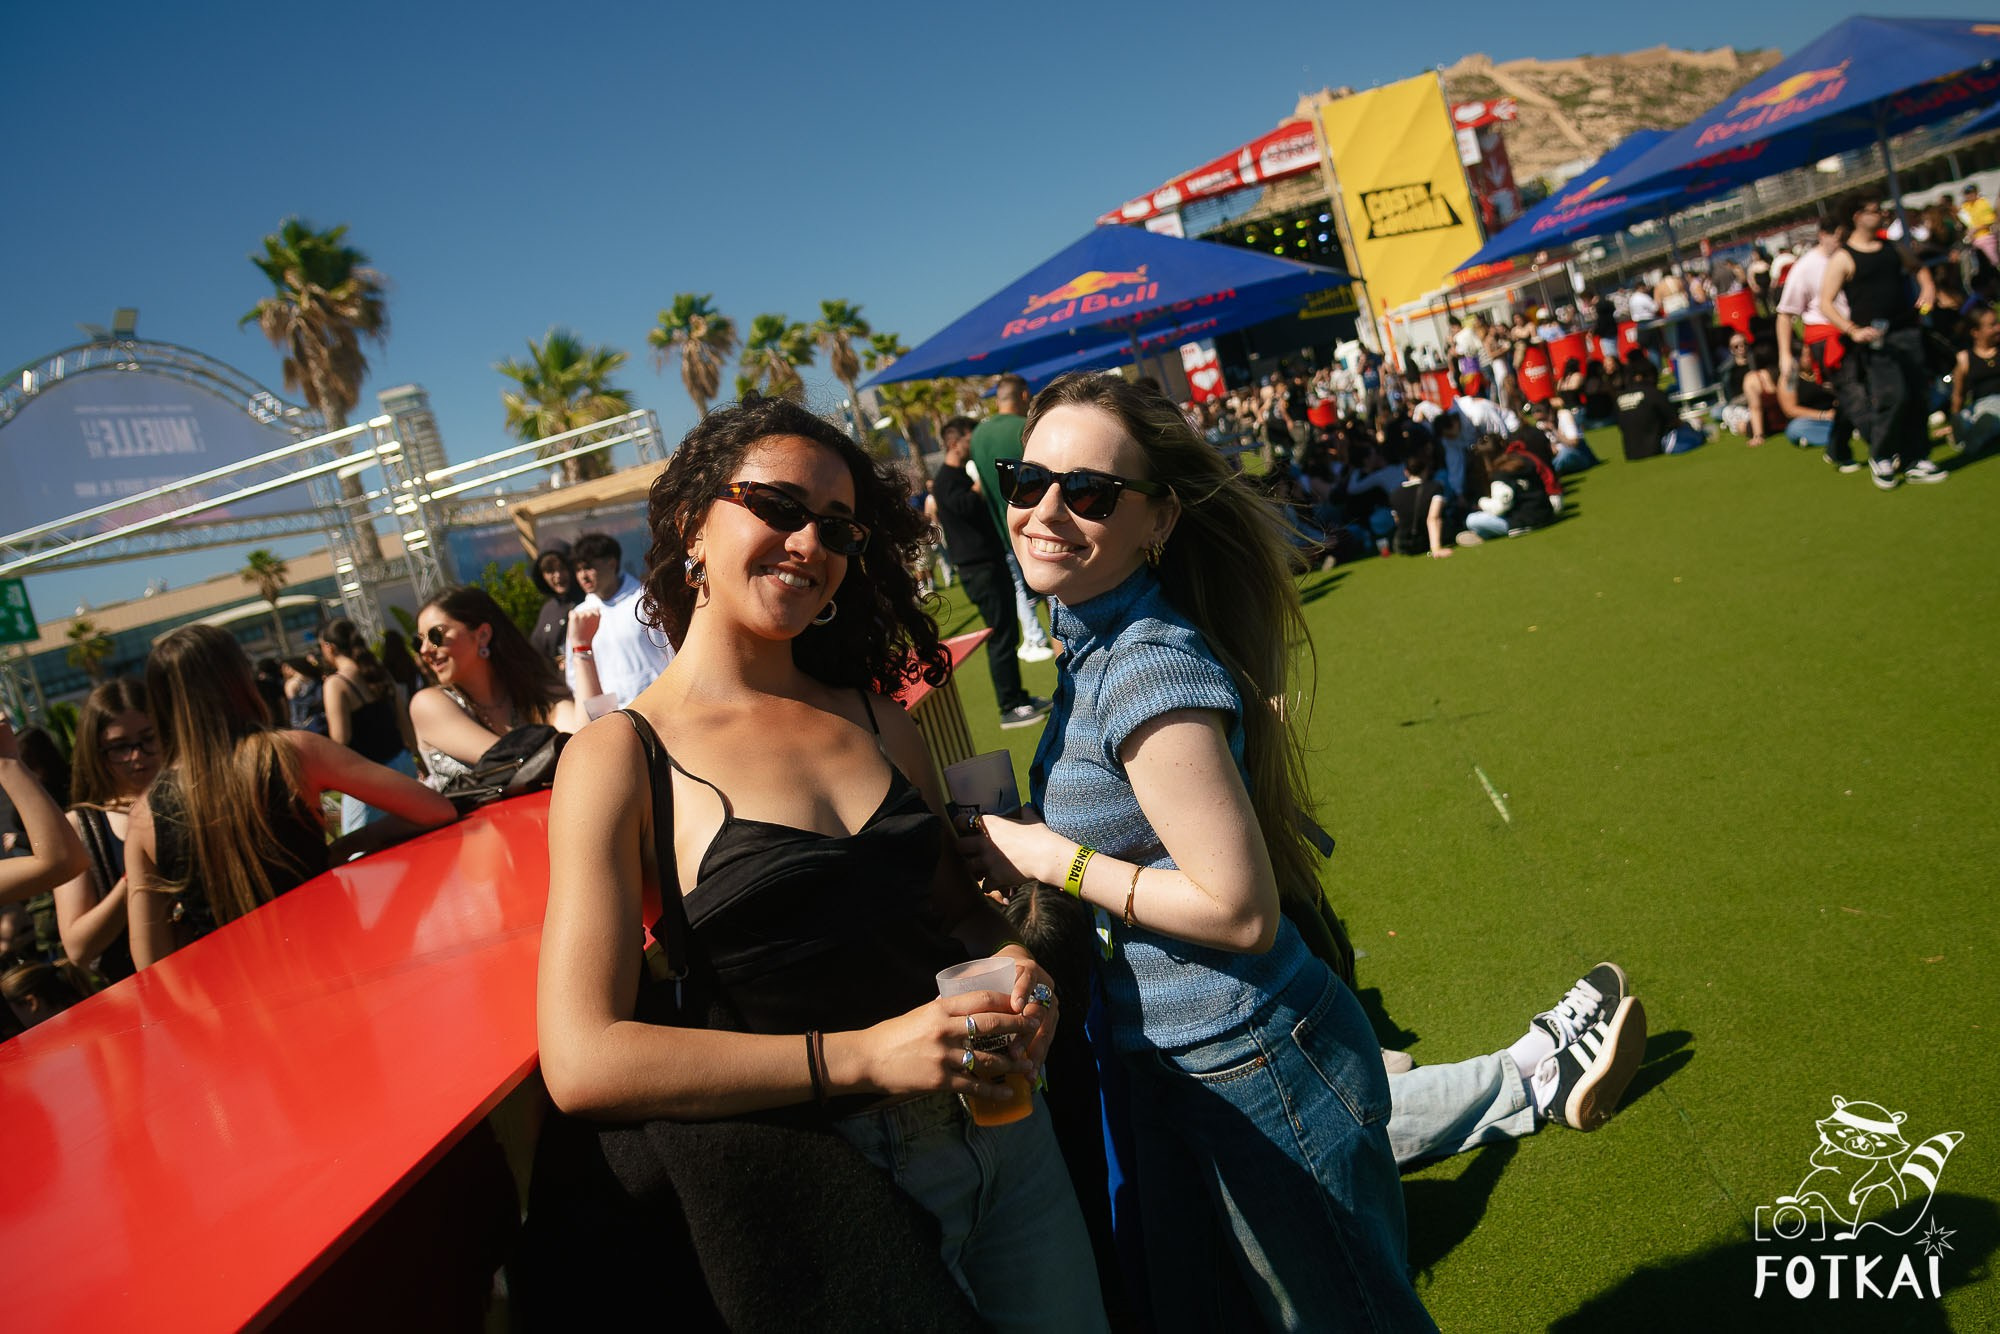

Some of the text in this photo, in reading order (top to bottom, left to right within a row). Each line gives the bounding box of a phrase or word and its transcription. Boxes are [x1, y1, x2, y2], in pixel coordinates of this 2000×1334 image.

[1694, 105, 1771, 148] Red
[1766, 77, 1847, 123] Bull
[1001, 300, 1077, 339] Red
[1080, 281, 1159, 314] Bull
[1068, 846, 1092, 882] ENERAL
